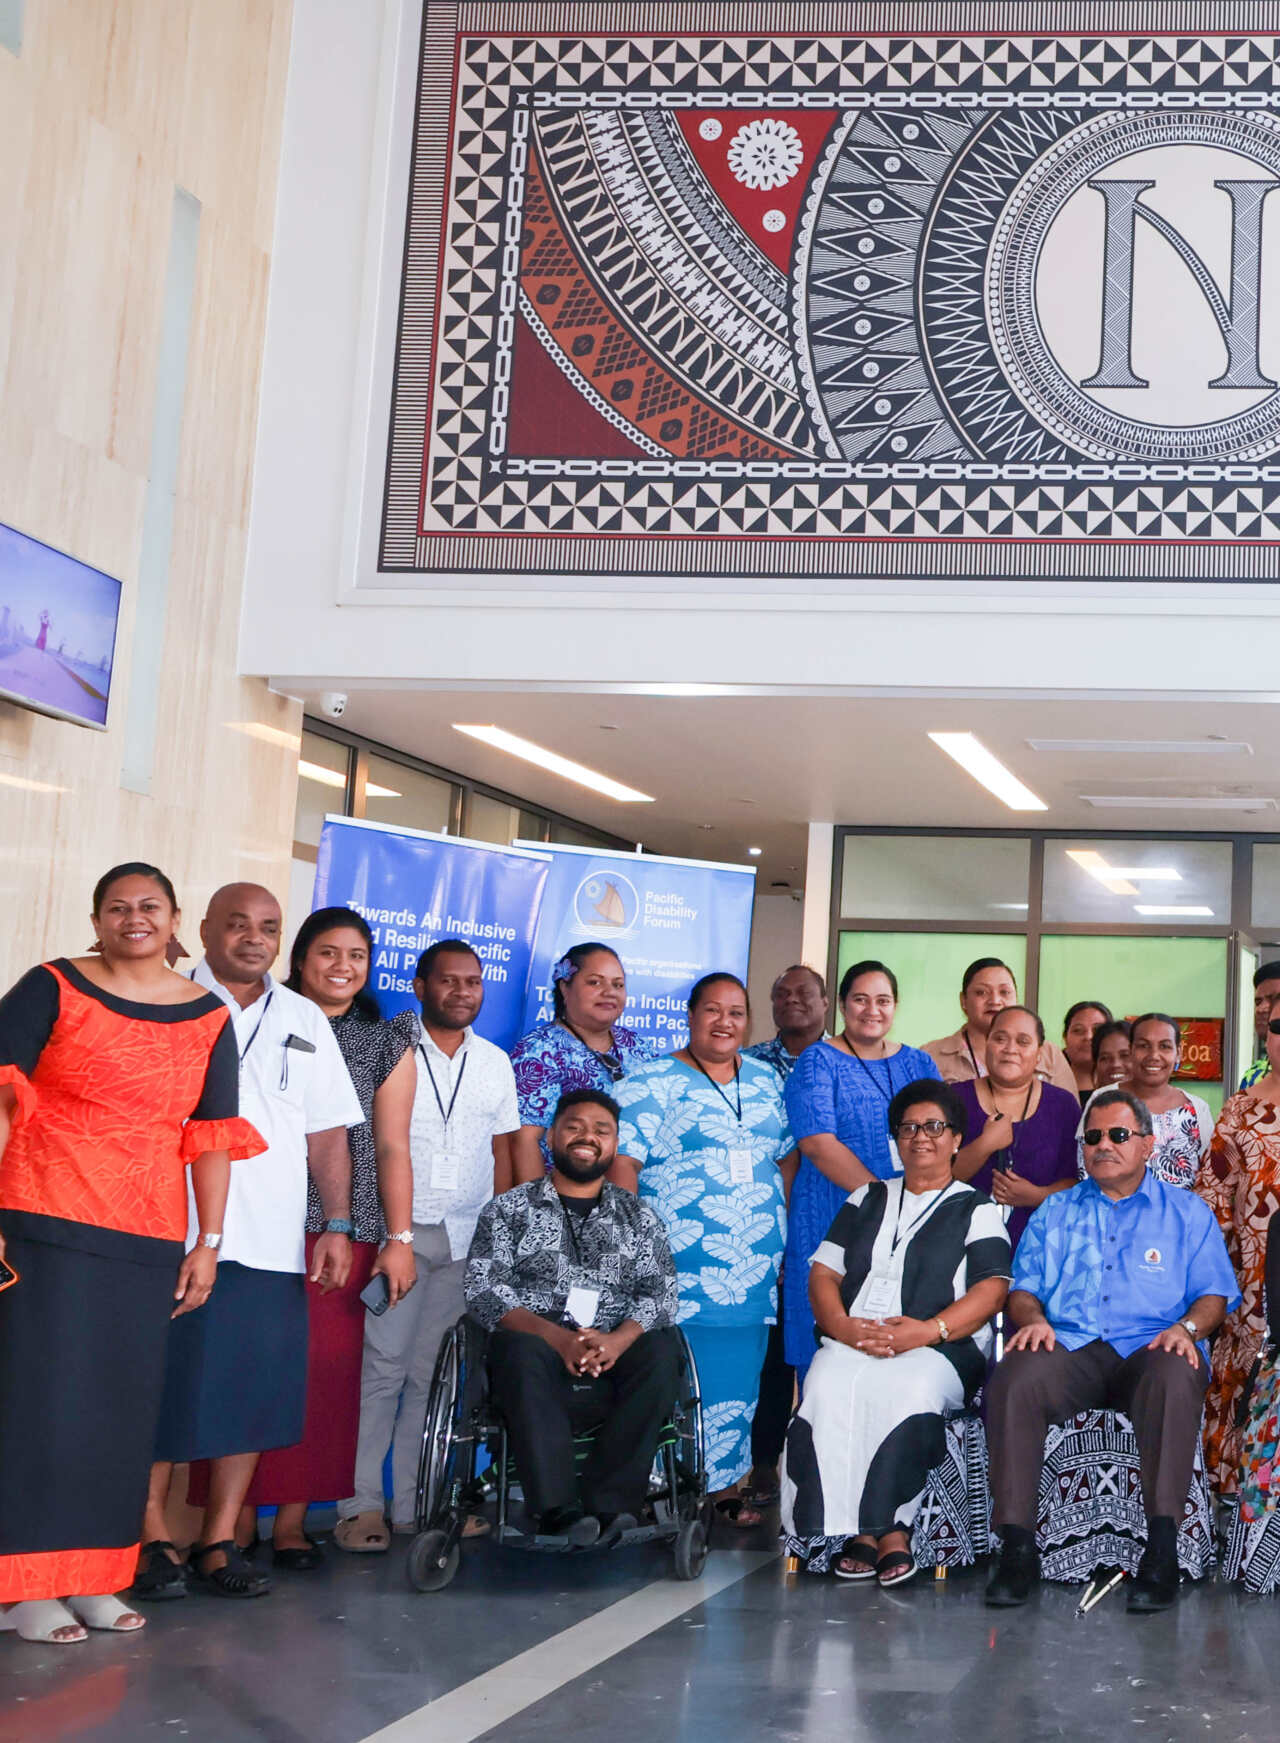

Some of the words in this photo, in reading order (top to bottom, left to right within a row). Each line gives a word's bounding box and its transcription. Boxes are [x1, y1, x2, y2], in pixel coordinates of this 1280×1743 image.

[646, 891, 684, 905] Pacific
[644, 903, 698, 921] Disability
[420, 911, 442, 930] An
[446, 915, 517, 941] Inclusive
[643, 915, 682, 929] Forum
[384, 928, 439, 950] Resili
[375, 950, 400, 969] All
[640, 993, 688, 1012] Inclus
